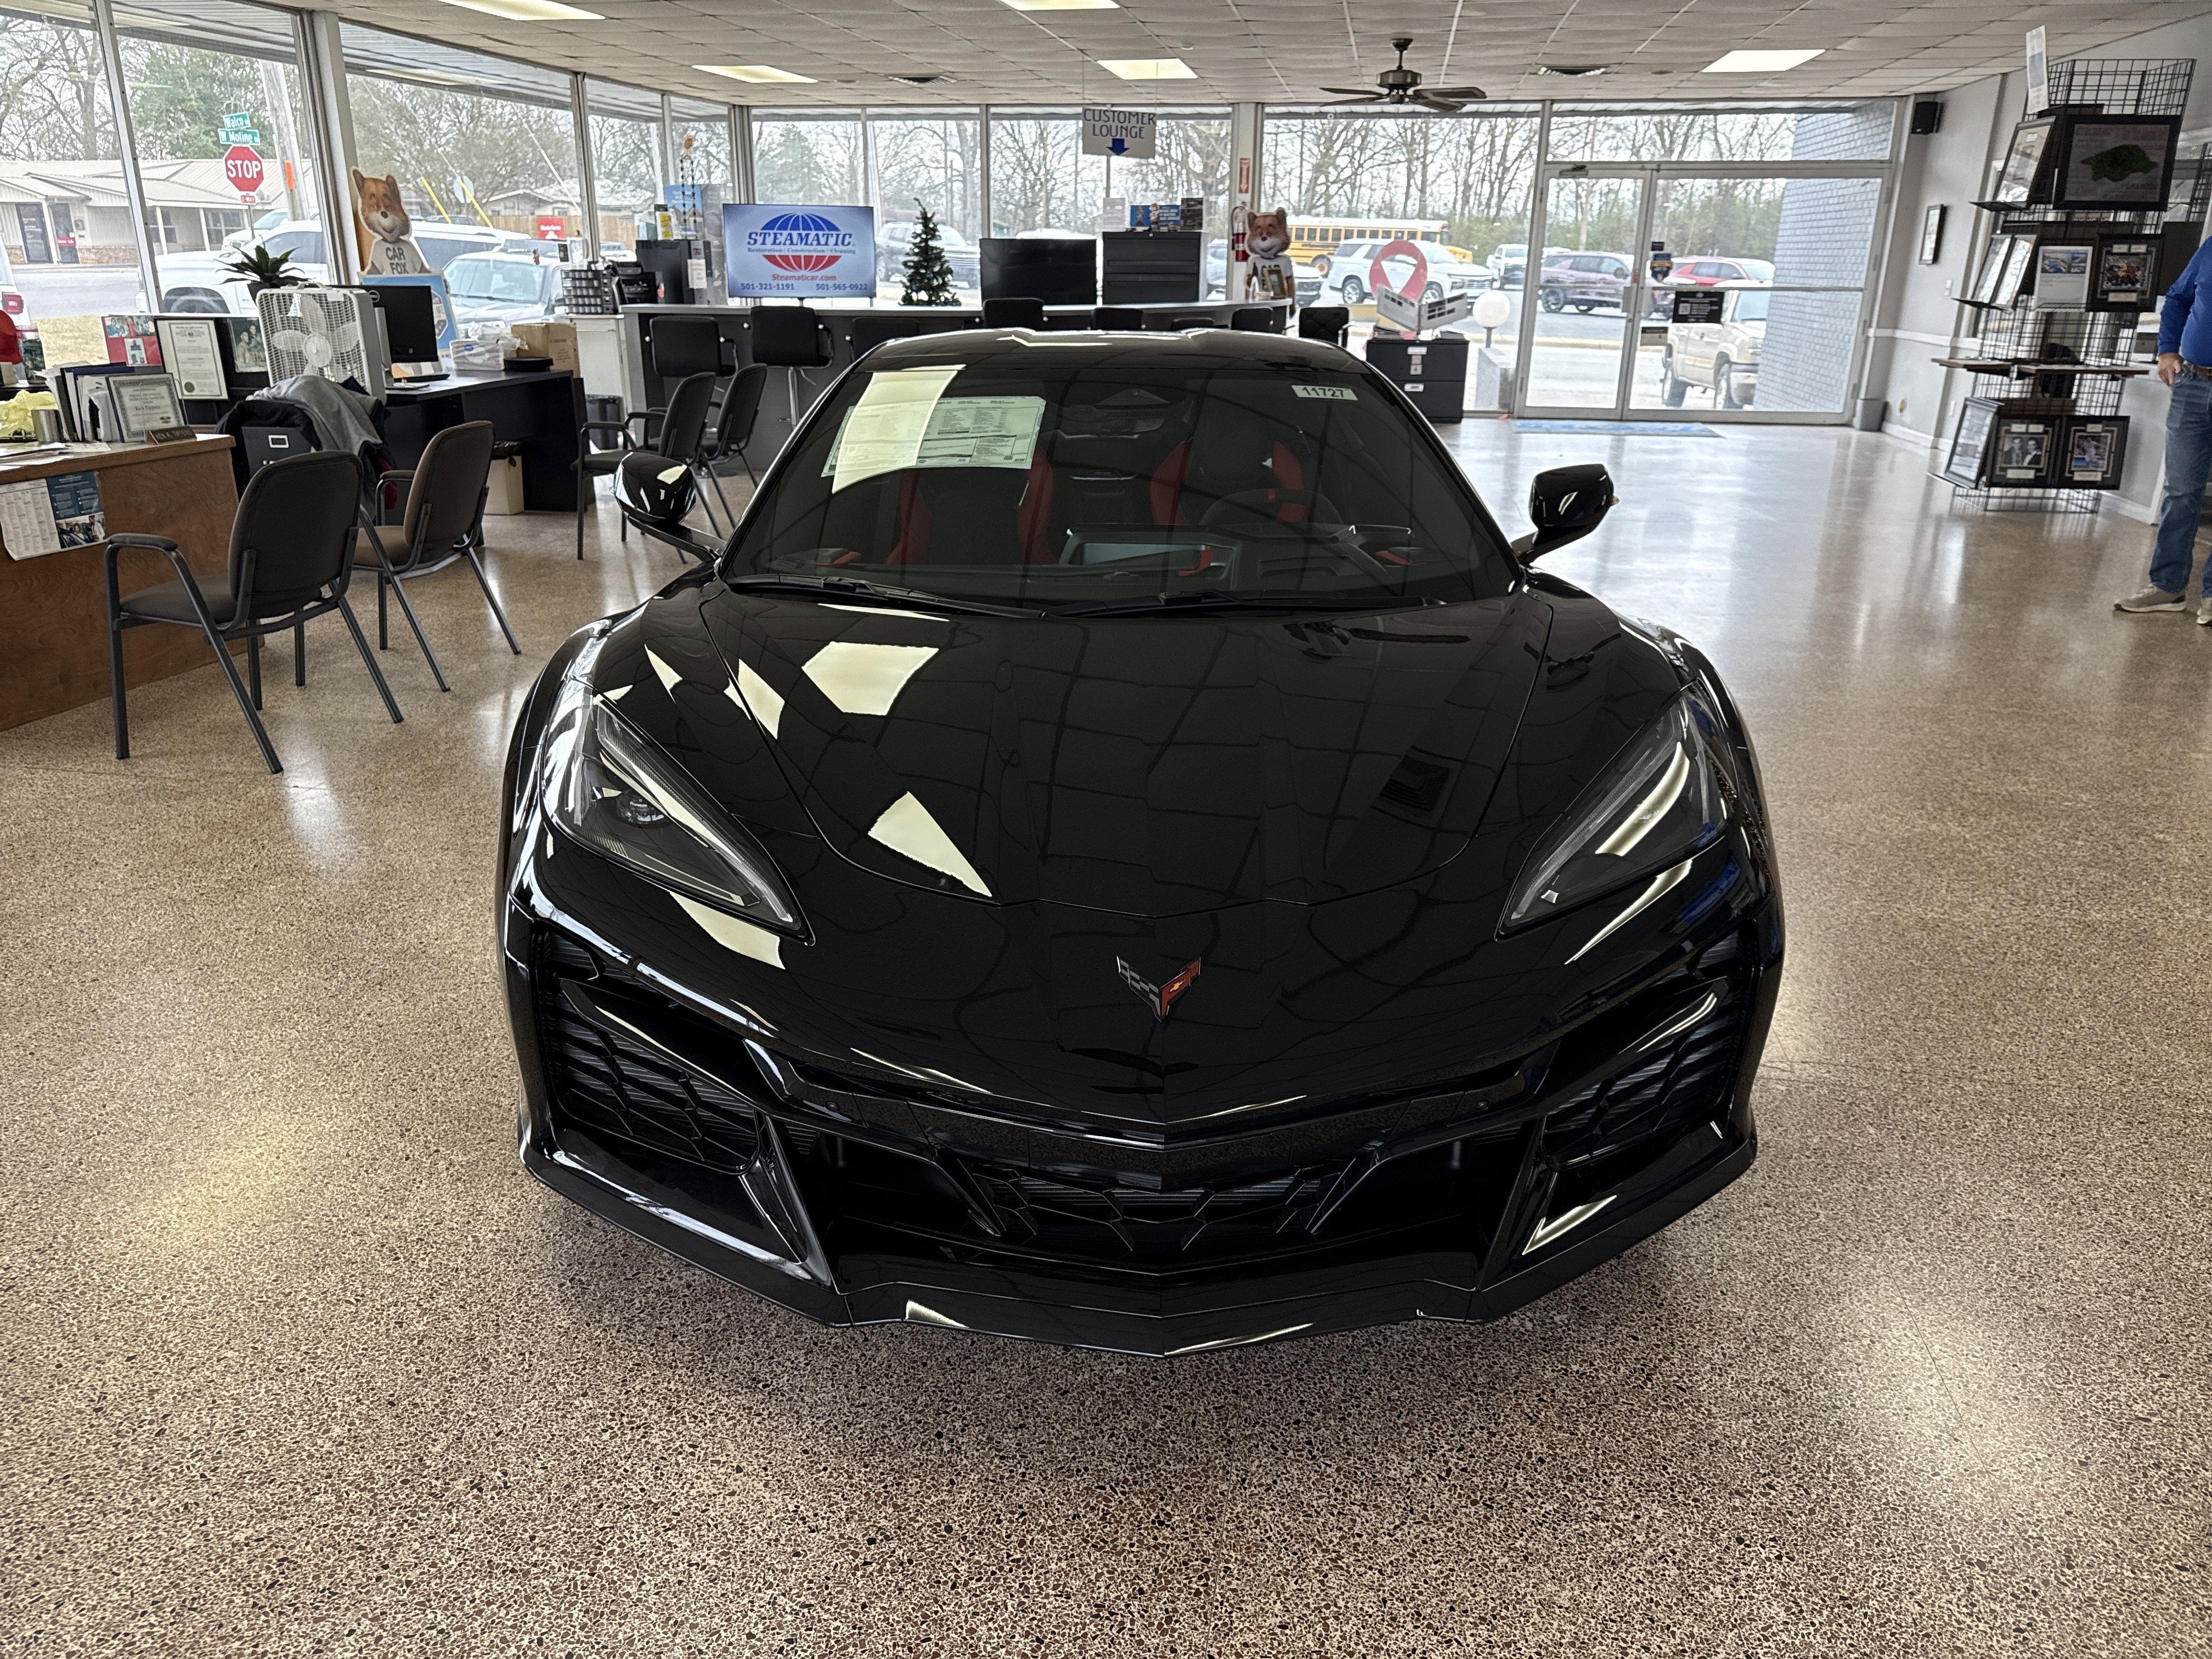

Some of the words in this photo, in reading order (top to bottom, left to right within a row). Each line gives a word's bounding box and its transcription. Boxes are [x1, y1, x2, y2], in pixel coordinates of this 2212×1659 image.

[225, 117, 244, 128] Walco
[1084, 109, 1156, 125] CUSTOMER
[220, 131, 227, 142] W
[228, 131, 253, 143] Moline
[1092, 123, 1145, 139] LOUNGE
[227, 160, 261, 178] STOP
[747, 232, 853, 246] STEAMATIC
[386, 247, 406, 261] CAR
[390, 262, 409, 274] FOX
[1302, 387, 1344, 398] 11727
